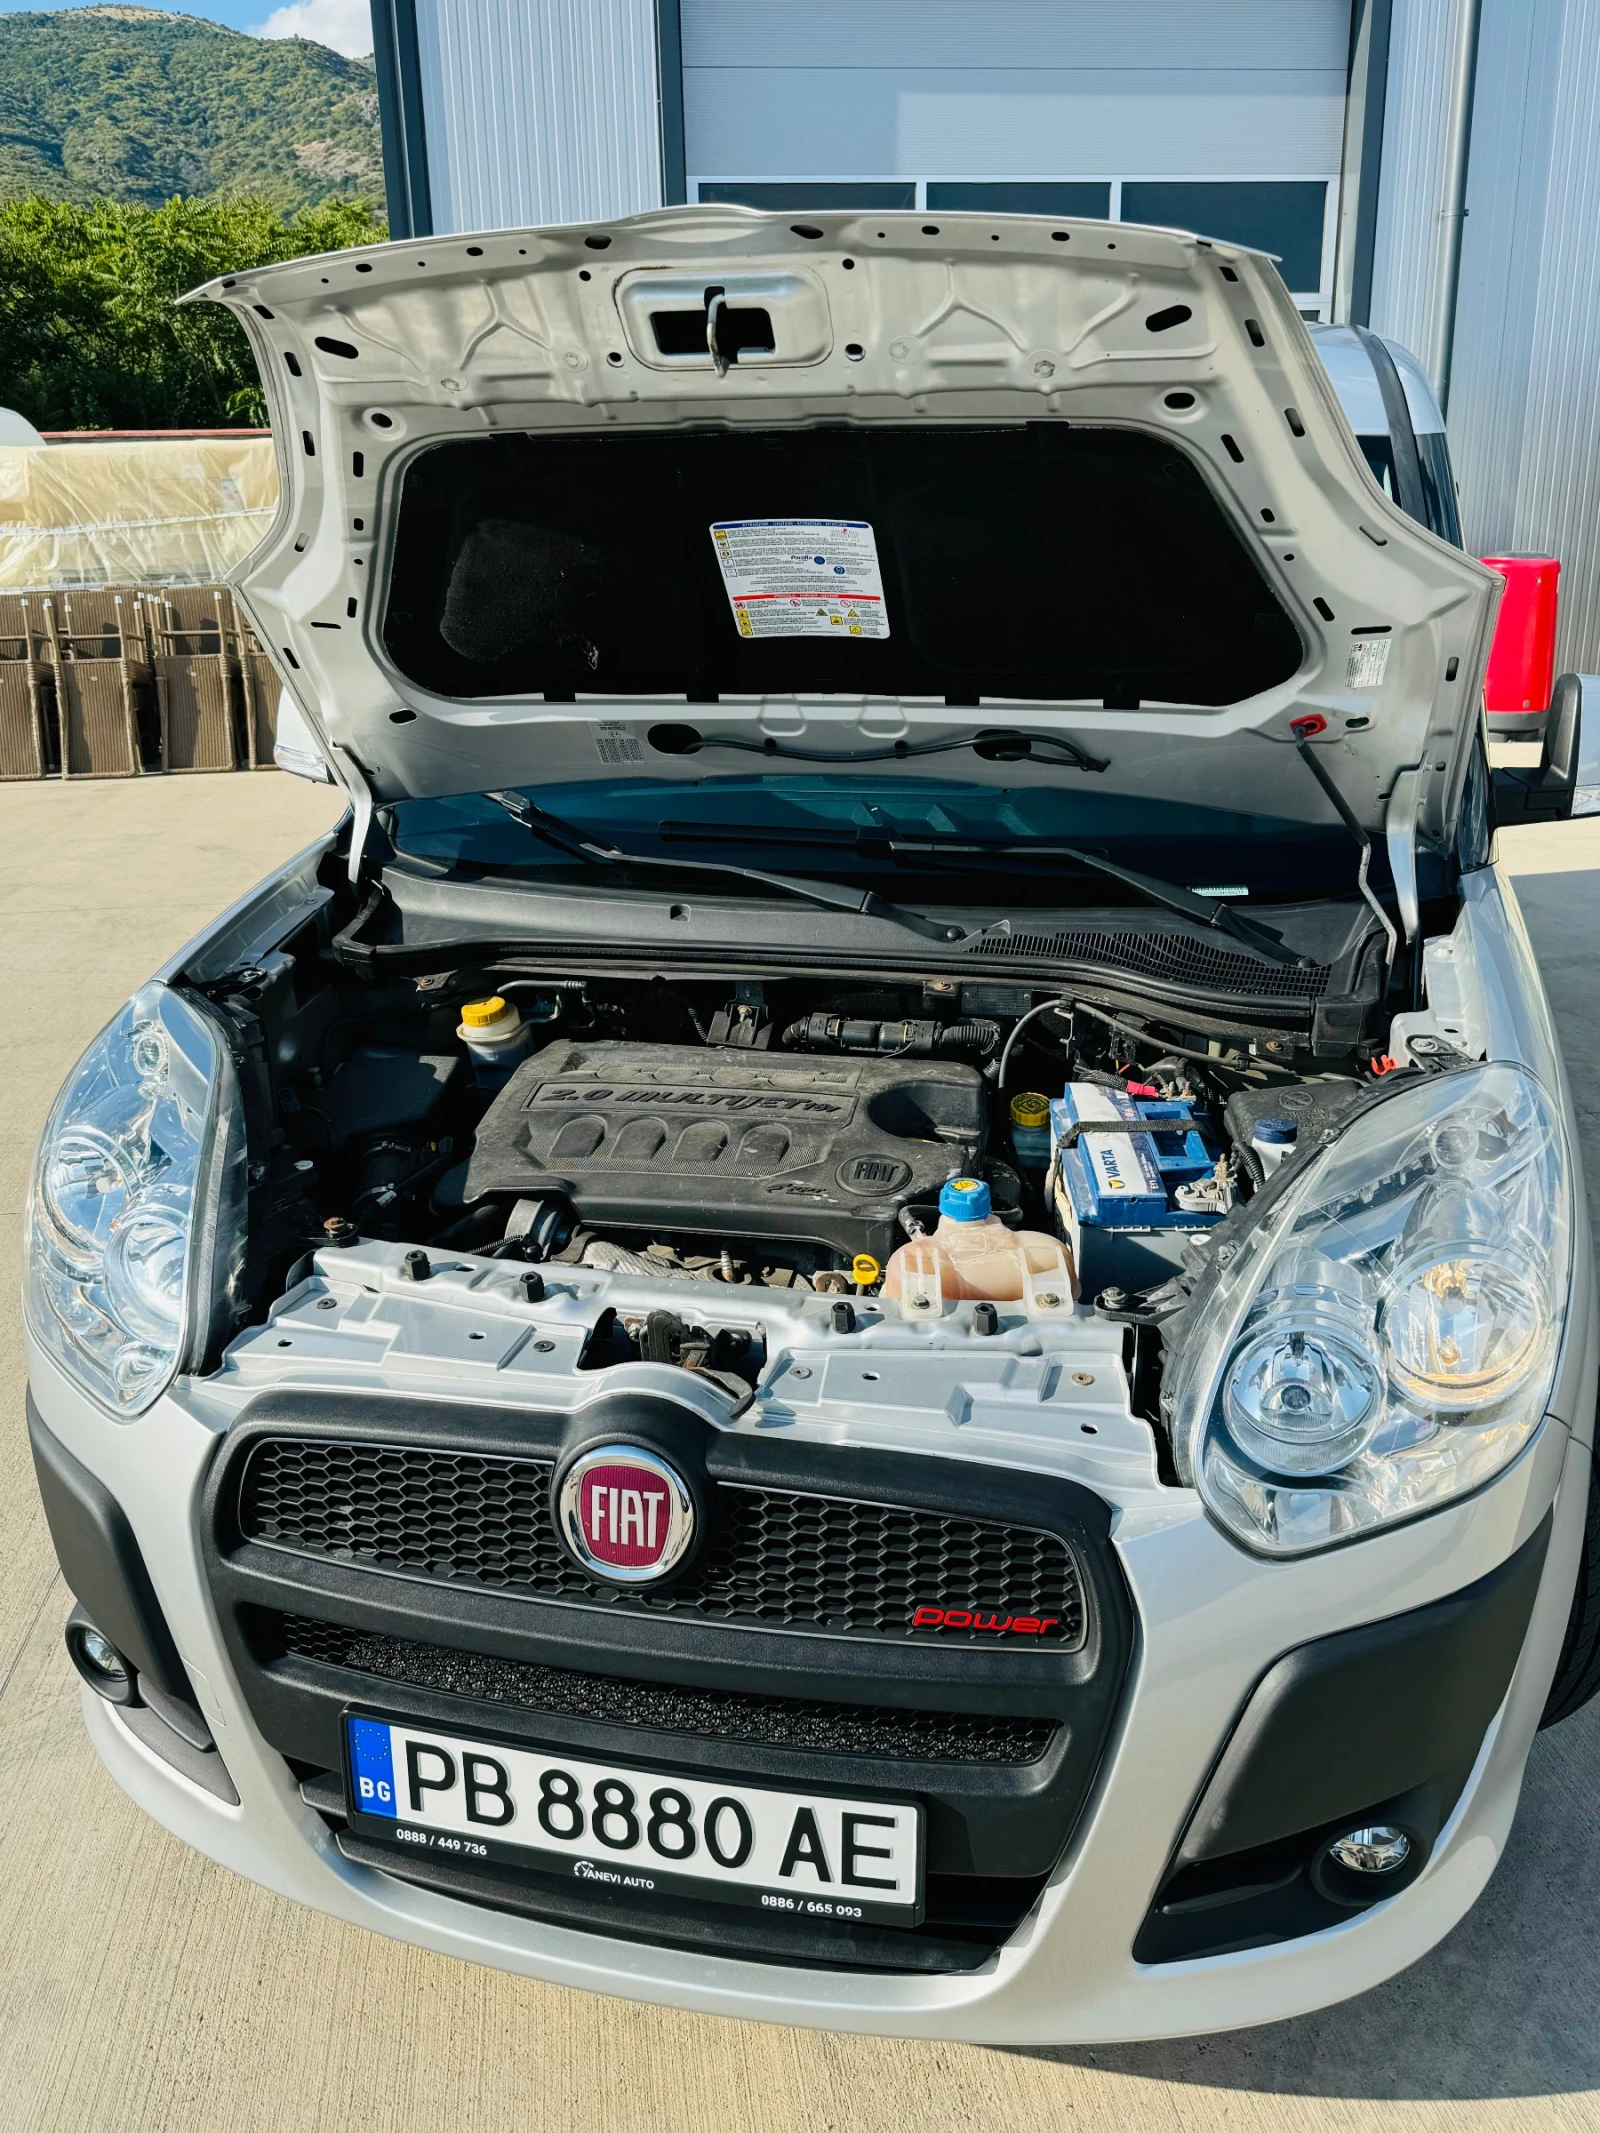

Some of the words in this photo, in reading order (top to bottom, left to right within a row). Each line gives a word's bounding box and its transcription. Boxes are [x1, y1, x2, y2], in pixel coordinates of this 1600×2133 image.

[540, 1089, 614, 1101] 2.0
[853, 1161, 900, 1183] FIAT
[1100, 1149, 1120, 1178] VARTA
[591, 1484, 666, 1549] FIAT
[912, 1606, 1059, 1635] power
[359, 1776, 392, 1803] BG
[404, 1740, 516, 1827] PB
[537, 1768, 754, 1869] 8880
[778, 1806, 899, 1890] AE
[396, 1828, 427, 1844] 0888
[437, 1837, 461, 1850] 449
[463, 1841, 488, 1856] 736
[623, 1876, 655, 1889] AUTO
[761, 1895, 795, 1909] 0886
[807, 1901, 833, 1914] 665
[836, 1905, 862, 1917] 093
